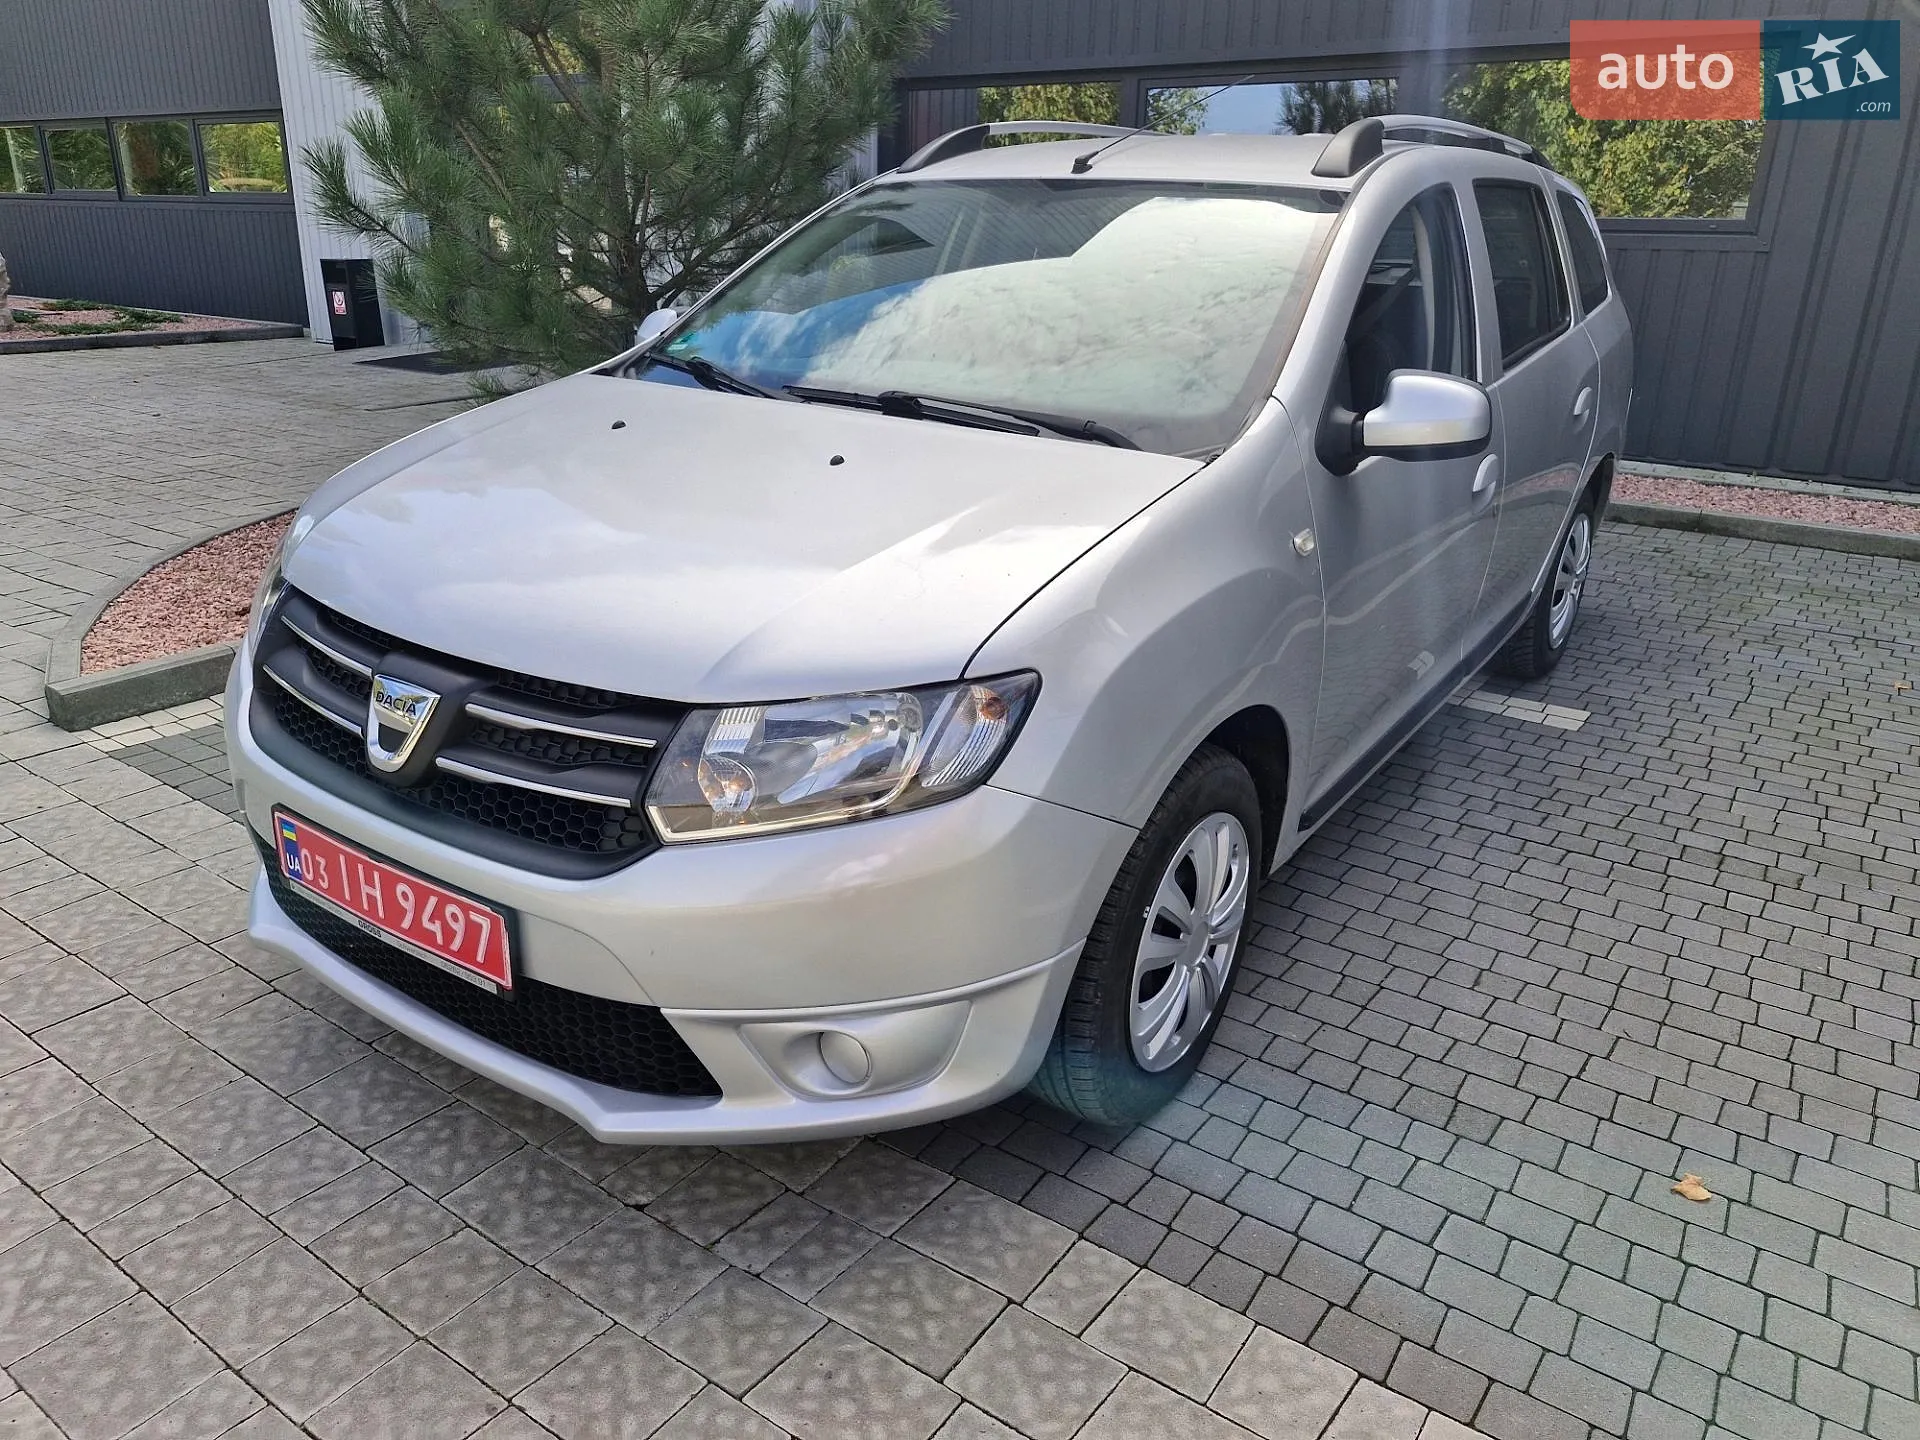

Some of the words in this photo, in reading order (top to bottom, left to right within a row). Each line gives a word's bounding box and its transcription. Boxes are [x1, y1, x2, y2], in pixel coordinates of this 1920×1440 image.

[375, 691, 417, 716] DACIA
[286, 852, 303, 875] UA
[301, 847, 329, 890] 03
[395, 882, 491, 964] 9497
